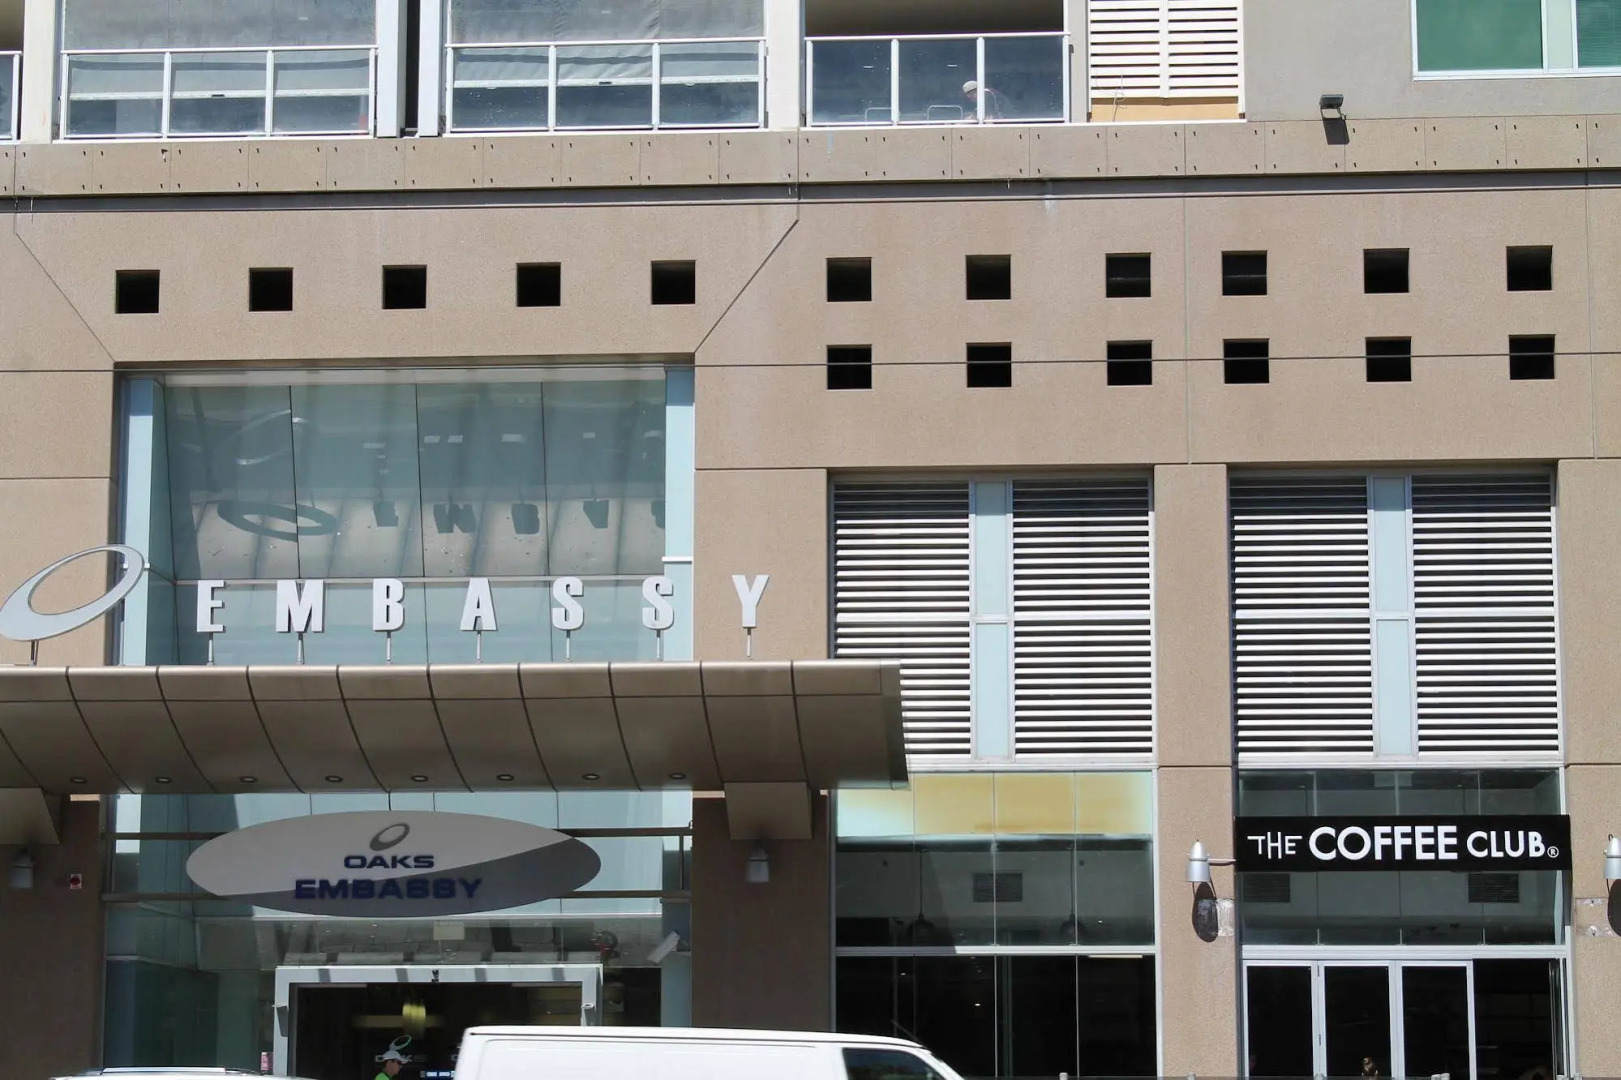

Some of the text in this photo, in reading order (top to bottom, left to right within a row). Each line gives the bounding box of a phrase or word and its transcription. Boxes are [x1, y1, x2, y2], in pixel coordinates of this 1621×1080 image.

[196, 574, 770, 634] EMBASSY
[1247, 831, 1303, 860] THE
[1308, 825, 1458, 861] COFFEE
[343, 855, 435, 869] OAKS
[294, 877, 483, 900] EMBASSY
